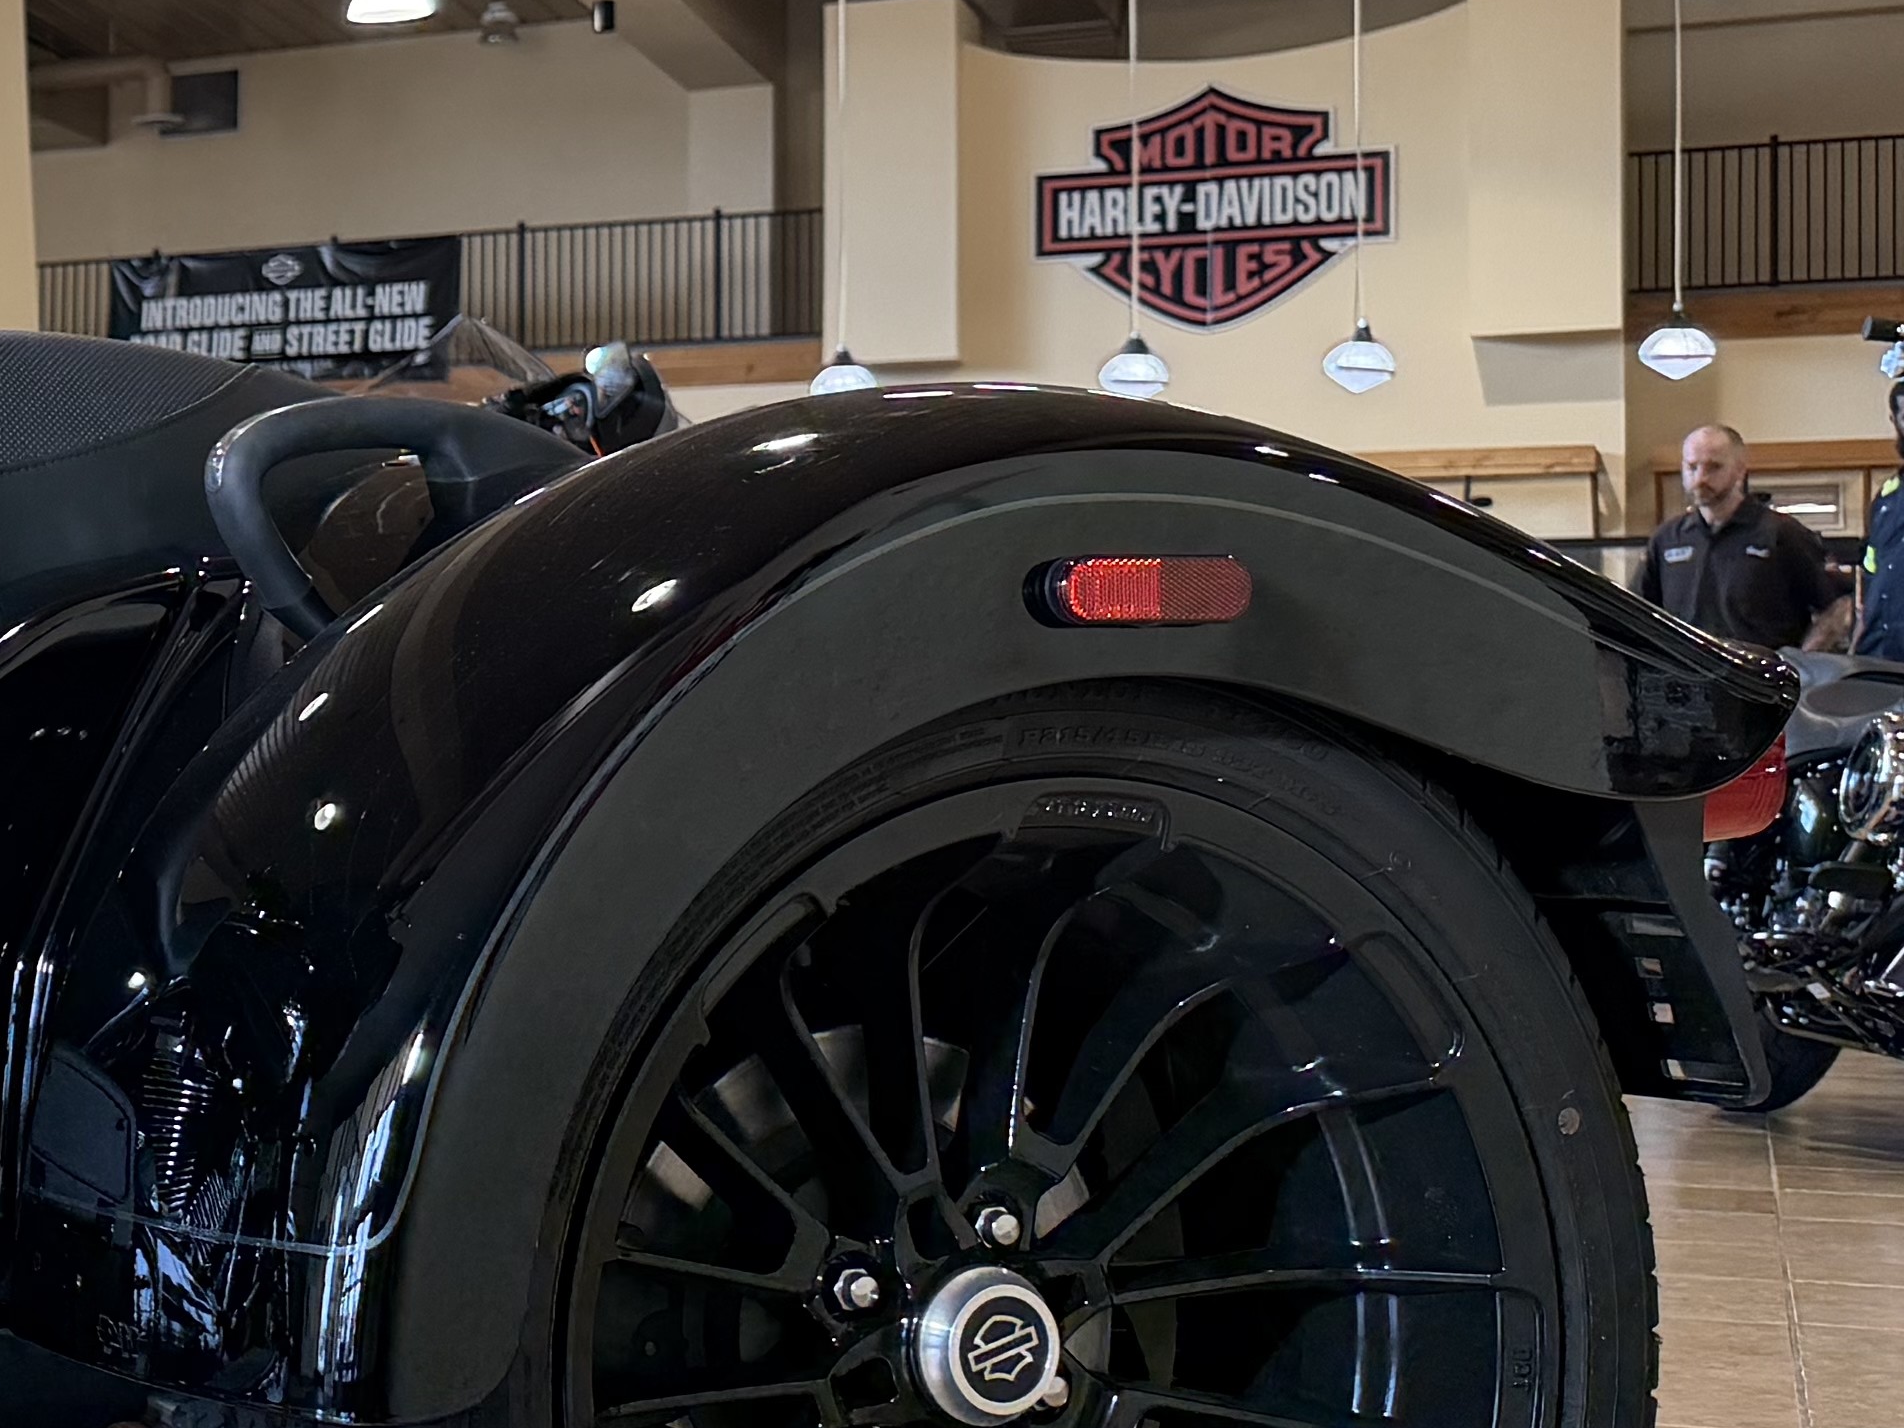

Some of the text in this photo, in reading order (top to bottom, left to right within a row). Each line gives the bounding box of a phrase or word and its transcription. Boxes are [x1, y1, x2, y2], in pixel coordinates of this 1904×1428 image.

[1137, 110, 1295, 170] MOTOR
[1058, 169, 1367, 239] HARLEY-DAVIDSON
[1136, 241, 1294, 309] CYCLES
[141, 280, 427, 331] INTRODUCING THE ALL-NEW
[186, 327, 249, 359] GLIDE
[252, 329, 282, 355] AND
[285, 320, 366, 359] STREET
[367, 315, 434, 350] GLIDE
